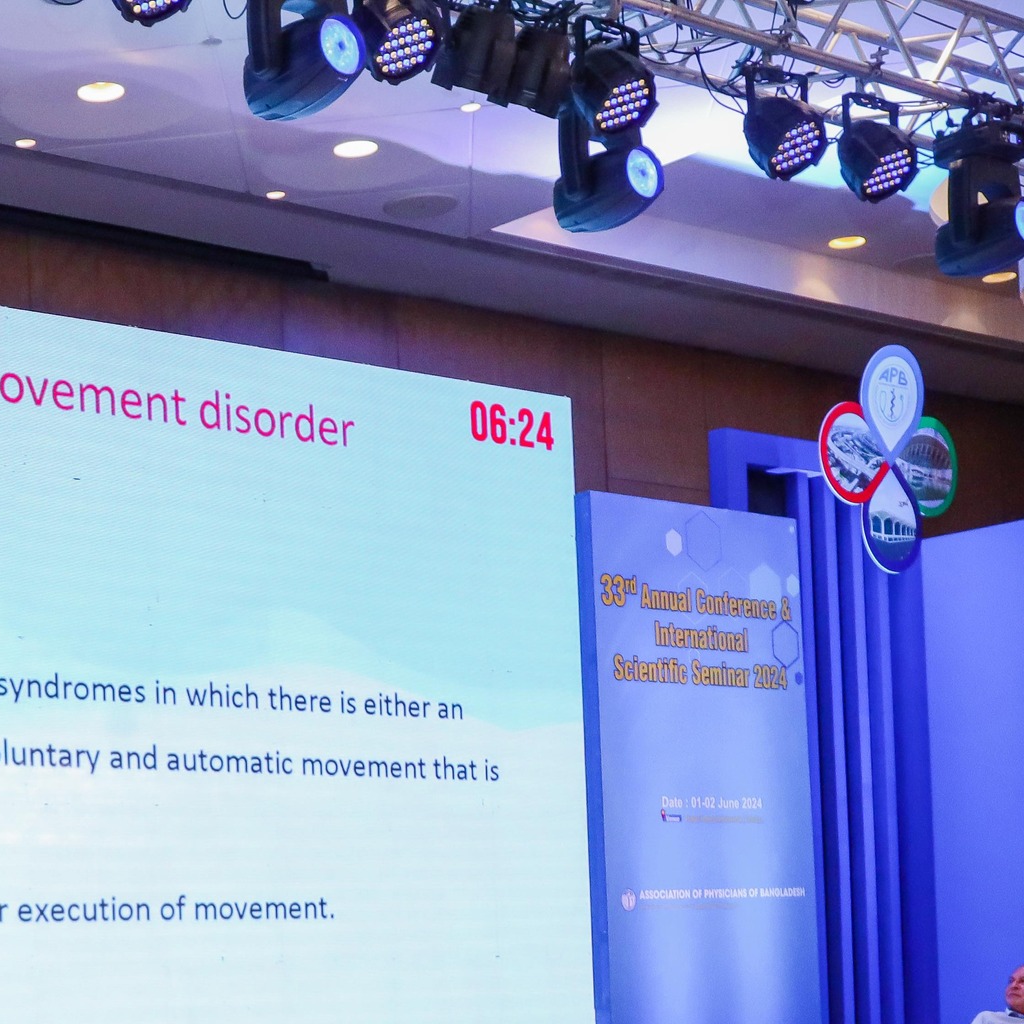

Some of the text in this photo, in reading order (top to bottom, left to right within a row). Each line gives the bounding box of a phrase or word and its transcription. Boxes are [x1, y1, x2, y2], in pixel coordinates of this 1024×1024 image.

[878, 367, 908, 386] APB
[200, 389, 356, 447] disorder
[470, 400, 555, 451] 06:24
[600, 573, 791, 621] 33rd Annual Conference &
[655, 620, 749, 653] International
[613, 653, 788, 690] Scientific Seminar 2024
[155, 680, 176, 705] in
[186, 681, 259, 710] which
[268, 686, 331, 714] there
[341, 690, 356, 714] is
[364, 693, 431, 718] either
[438, 701, 464, 720] an
[110, 745, 157, 770] and
[167, 750, 293, 775] automatic
[302, 753, 427, 780] movement
[433, 756, 477, 780] that
[484, 759, 499, 781] is
[691, 796, 715, 809] 01-02
[718, 797, 739, 809] June
[742, 797, 763, 809] 2024
[18, 898, 150, 924] execution
[160, 895, 186, 922] of
[195, 897, 335, 921] movement.
[640, 887, 805, 900] ASSOCIATION OF PHYSICIANS OF BANGLADESH
